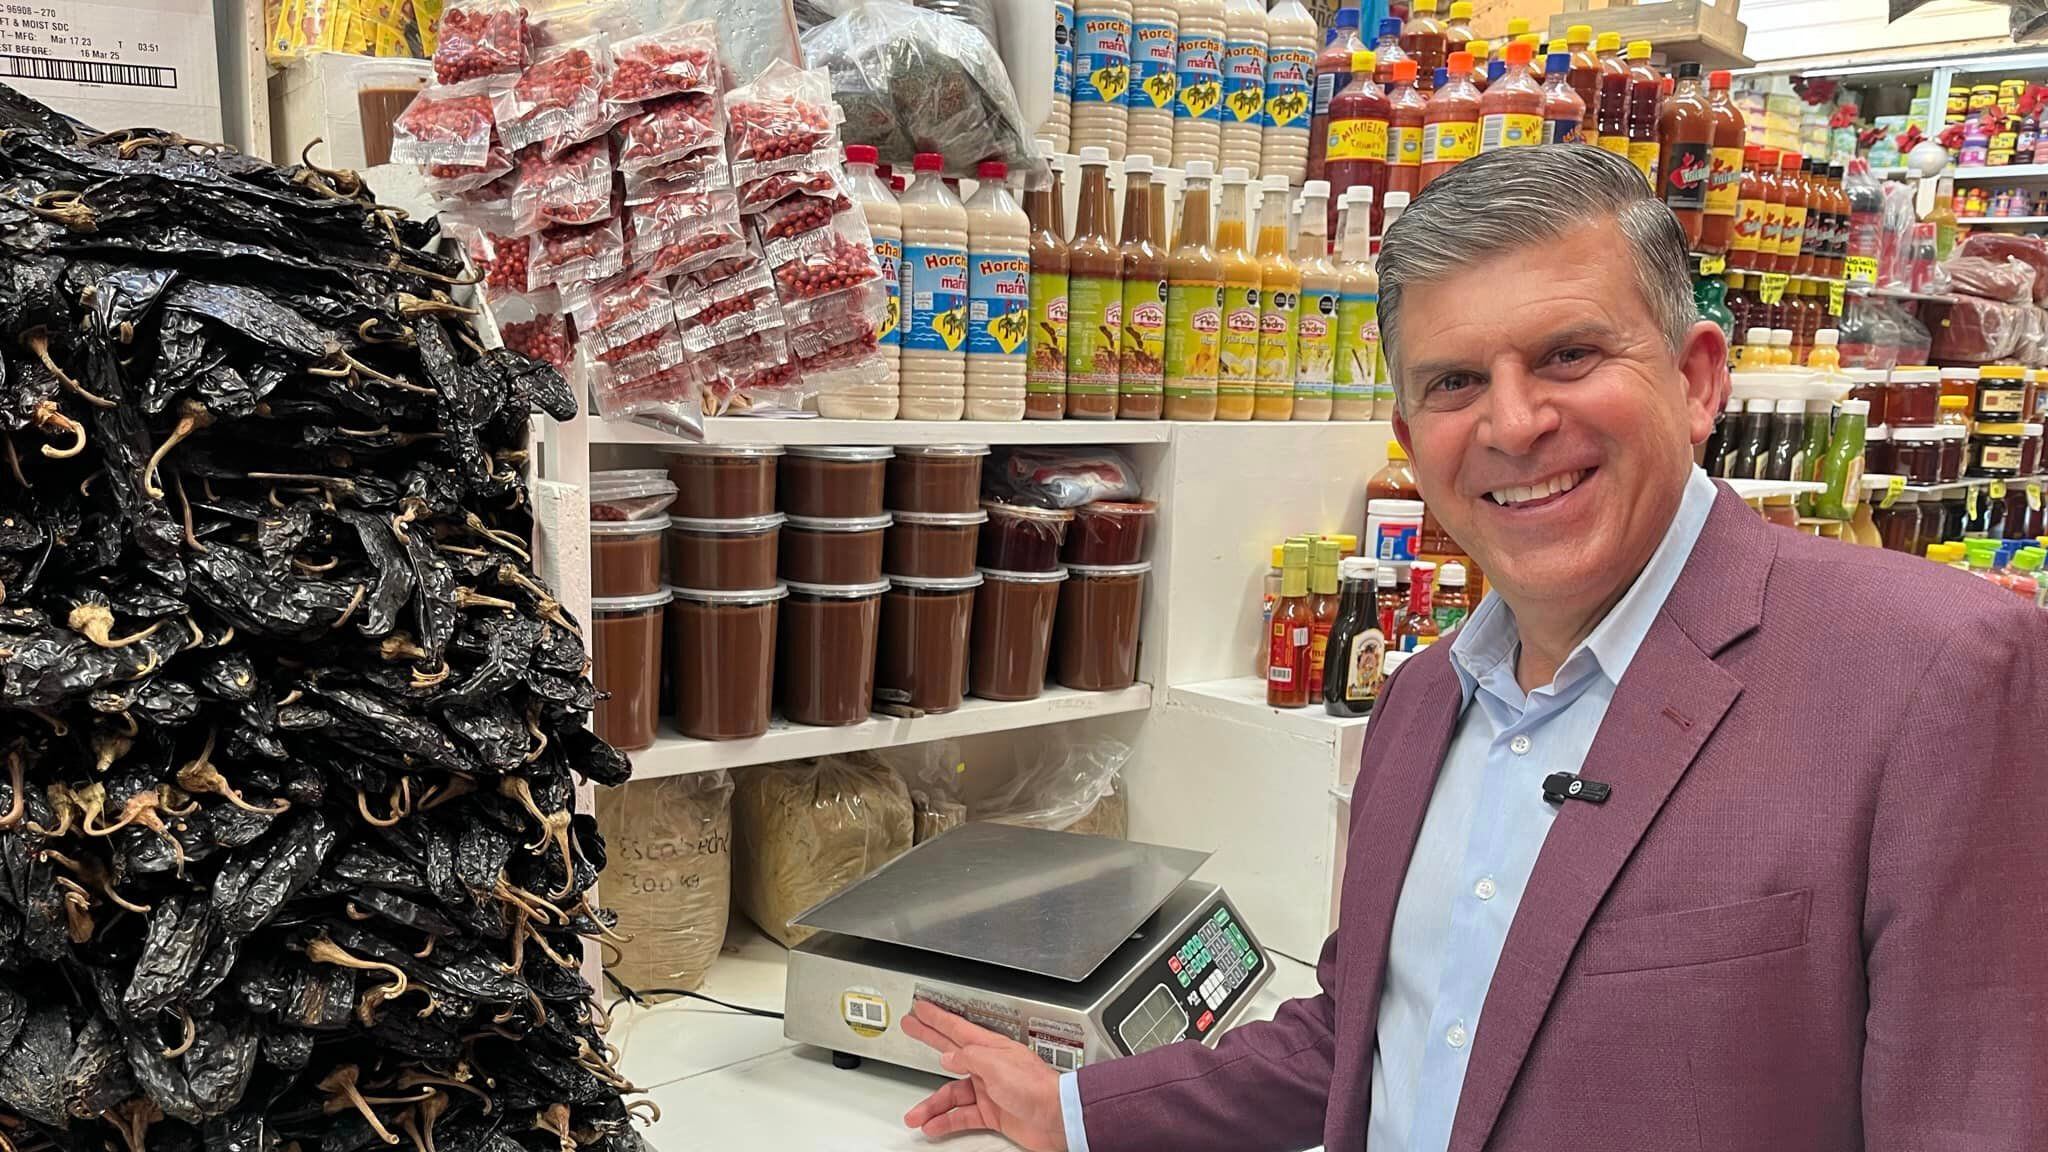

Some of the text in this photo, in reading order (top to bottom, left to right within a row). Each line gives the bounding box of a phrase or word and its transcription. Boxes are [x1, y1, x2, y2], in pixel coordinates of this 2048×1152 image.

[13, 18, 20, 28] &
[22, 20, 49, 31] MOIST
[51, 35, 66, 45] Mar
[70, 36, 79, 46] 17
[81, 38, 92, 47] 23
[138, 43, 159, 53] 03:51
[80, 49, 90, 58] 16
[92, 50, 108, 60] Mar
[110, 51, 120, 60] 25
